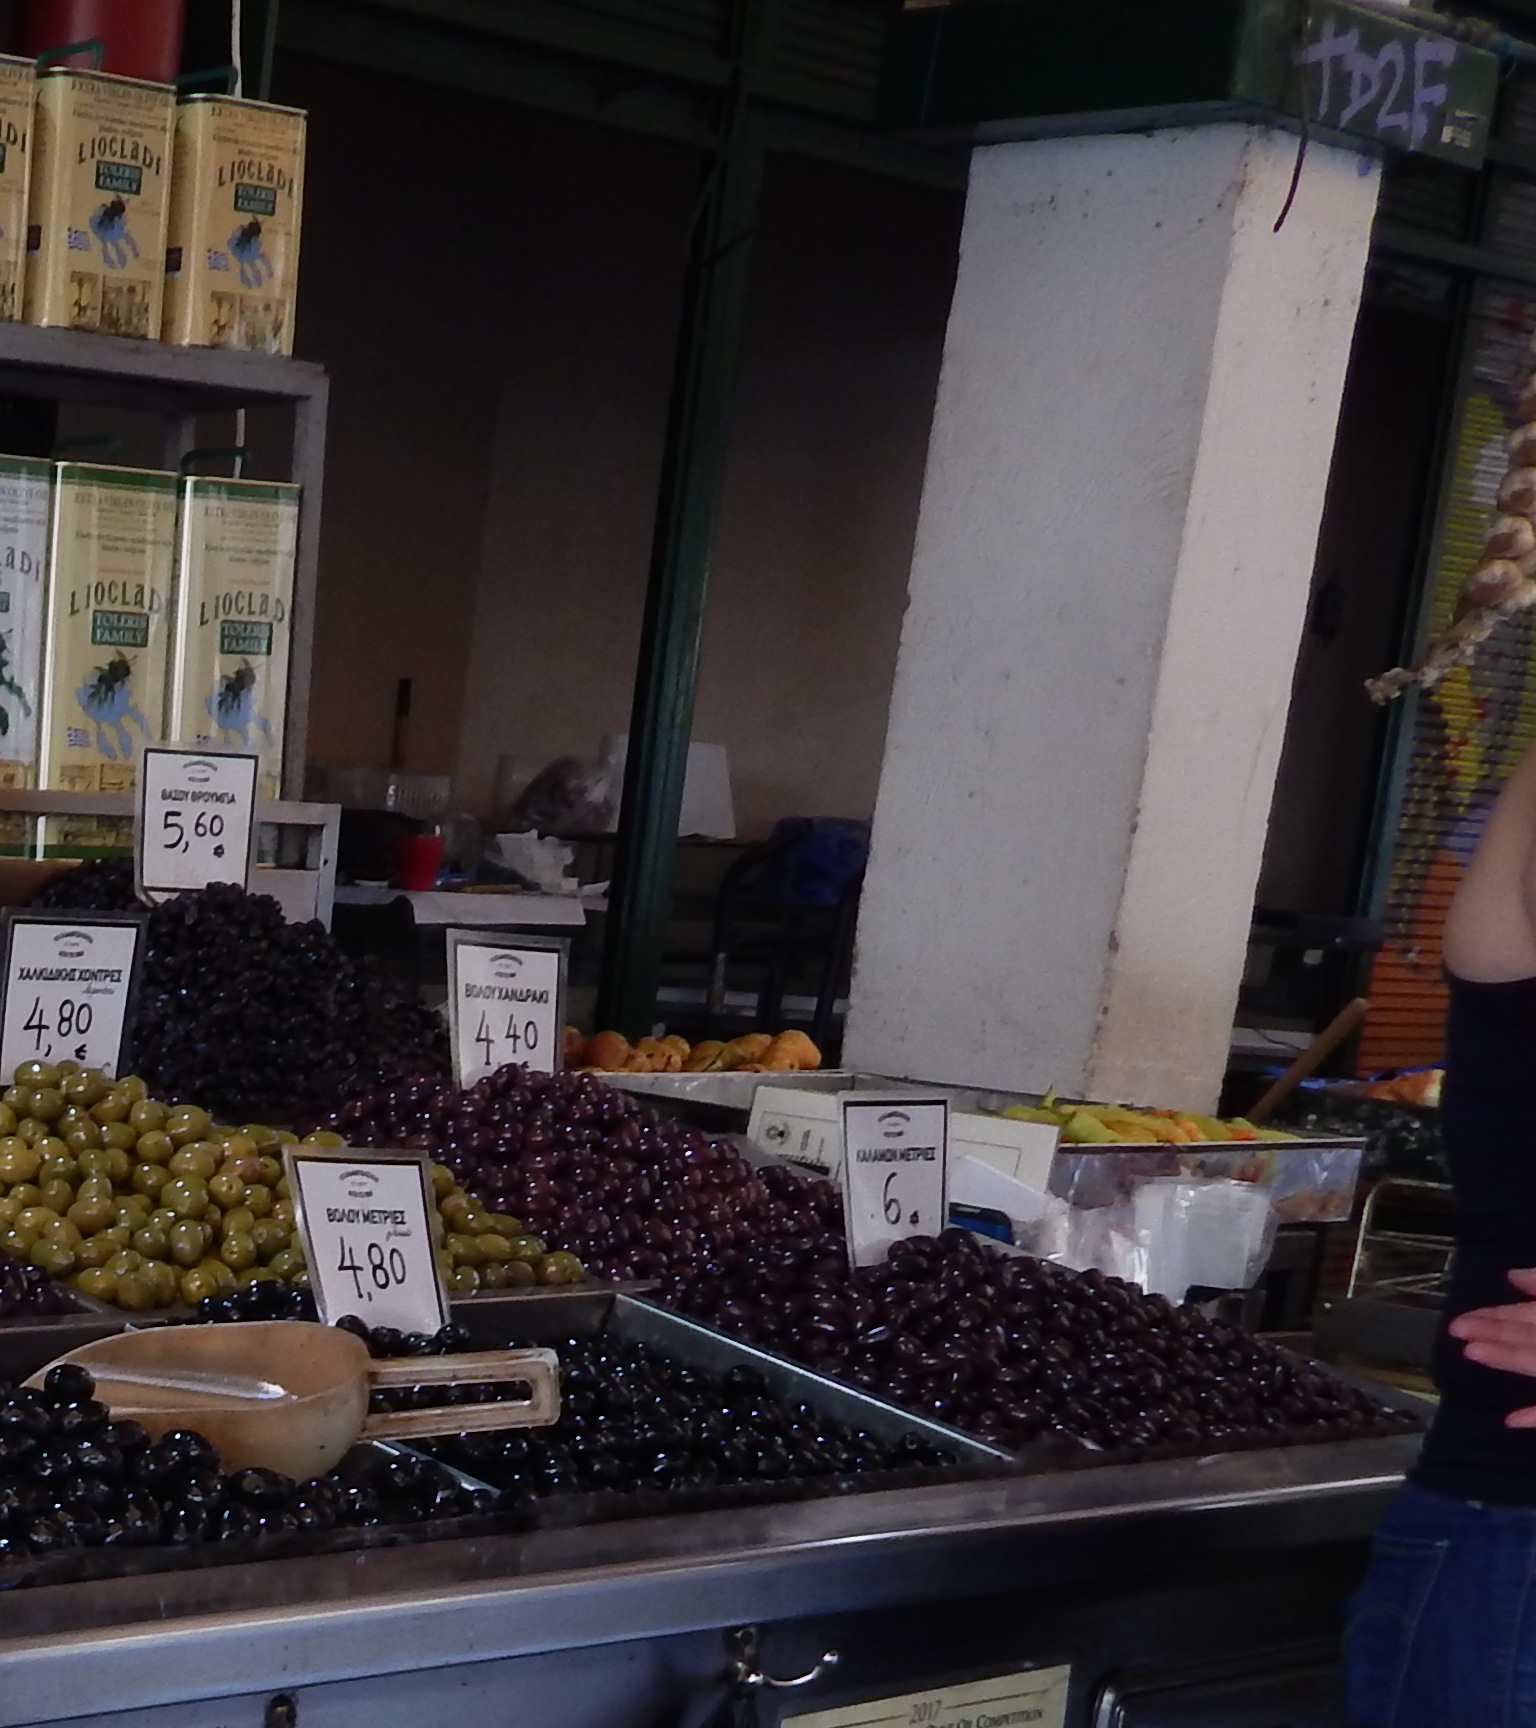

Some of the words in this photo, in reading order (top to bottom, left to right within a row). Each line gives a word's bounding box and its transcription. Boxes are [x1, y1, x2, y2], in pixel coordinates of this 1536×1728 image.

[95, 627, 144, 645] FAMILY
[163, 811, 224, 853] 5,60
[23, 996, 93, 1057] 4,80
[883, 1171, 902, 1225] 6
[338, 1236, 406, 1302] 4,80
